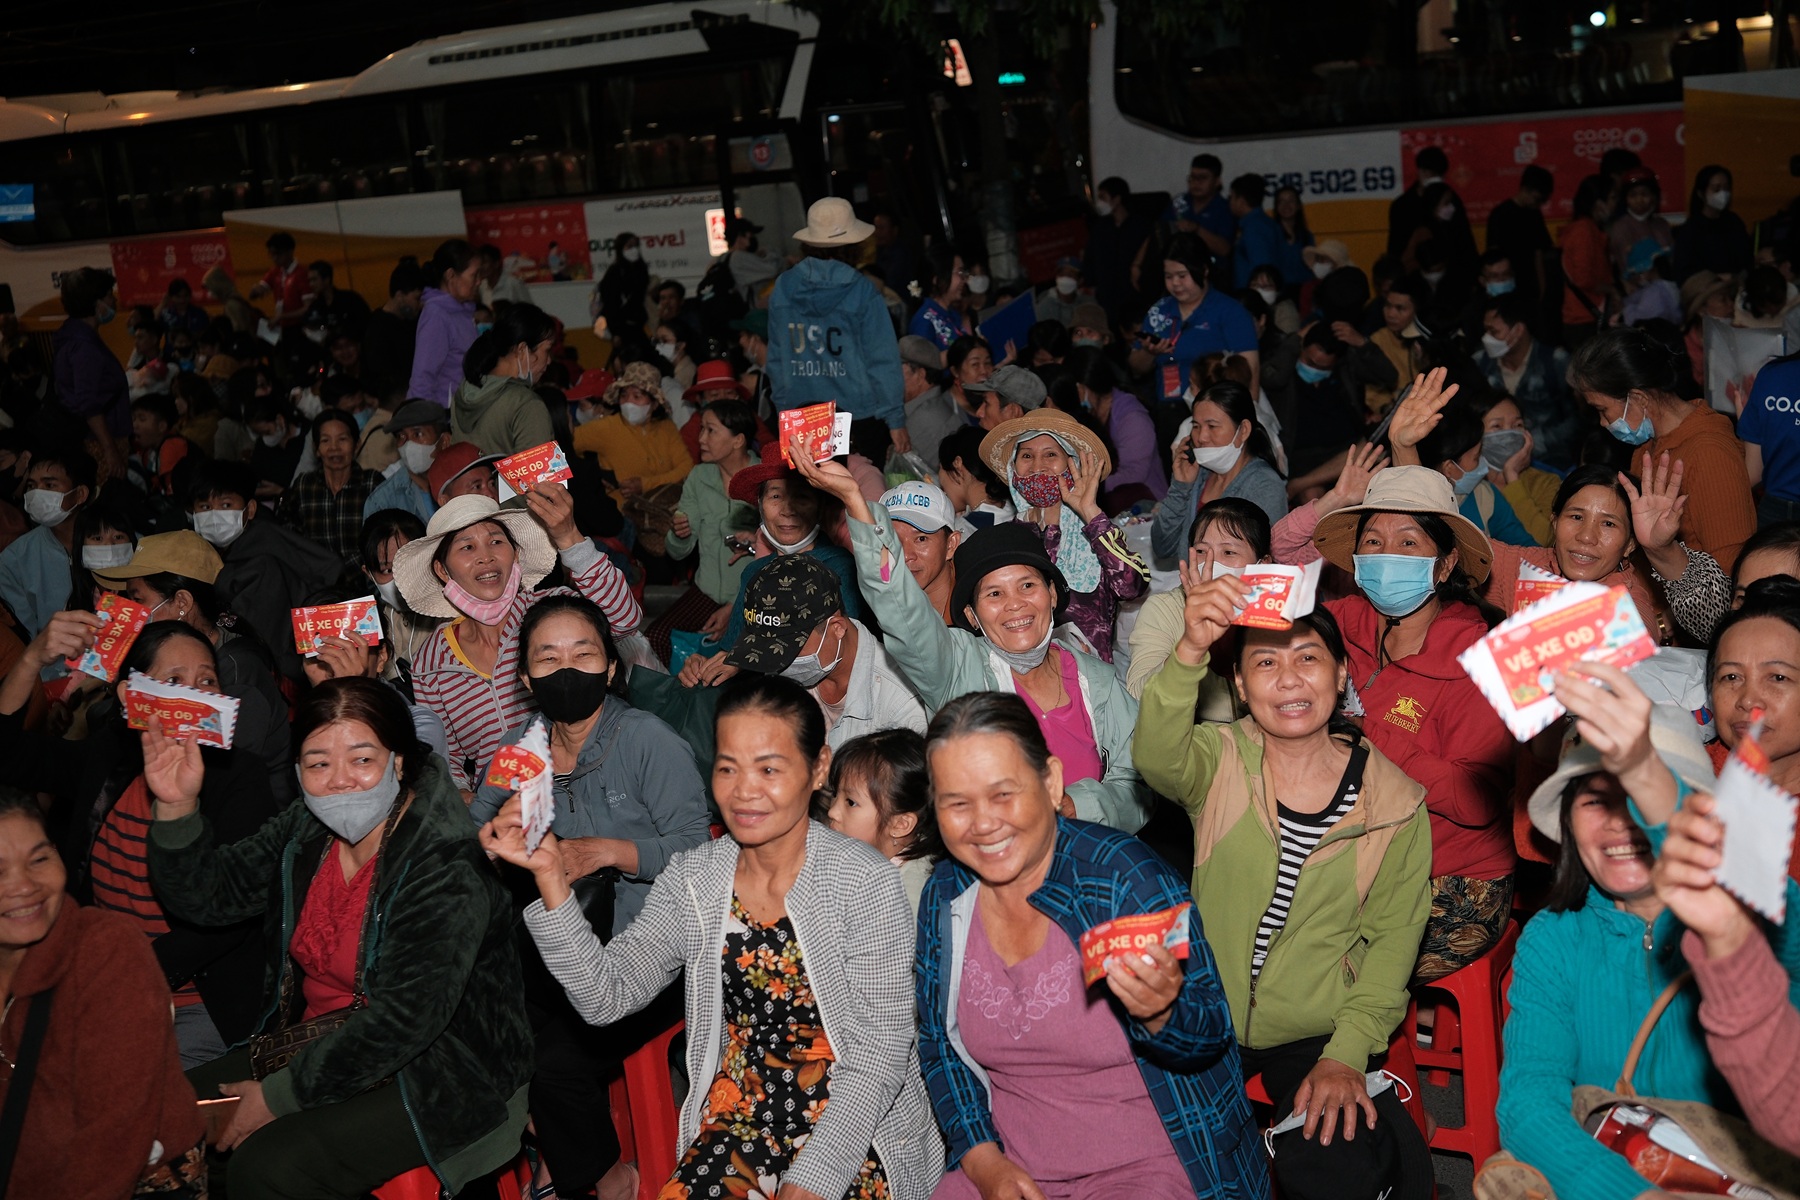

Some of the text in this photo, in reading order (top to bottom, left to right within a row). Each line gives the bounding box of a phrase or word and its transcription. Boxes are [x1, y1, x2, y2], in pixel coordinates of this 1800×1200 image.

[788, 322, 842, 356] USC
[790, 360, 847, 377] TROJANS
[514, 466, 529, 478] XE
[117, 607, 134, 623] VÉ
[744, 608, 781, 627] adidas
[109, 622, 126, 637] XE
[298, 618, 315, 632] VÉ
[316, 619, 332, 630] XE
[1504, 646, 1536, 673] VÉ
[1533, 636, 1565, 662] XE
[134, 702, 152, 714] VÉ
[154, 708, 171, 719] XE
[1383, 712, 1420, 734] BURBERRY
[499, 758, 518, 771] VÉ
[519, 764, 536, 780] XE
[1086, 938, 1106, 959] VÉ
[1108, 934, 1132, 951] XE
